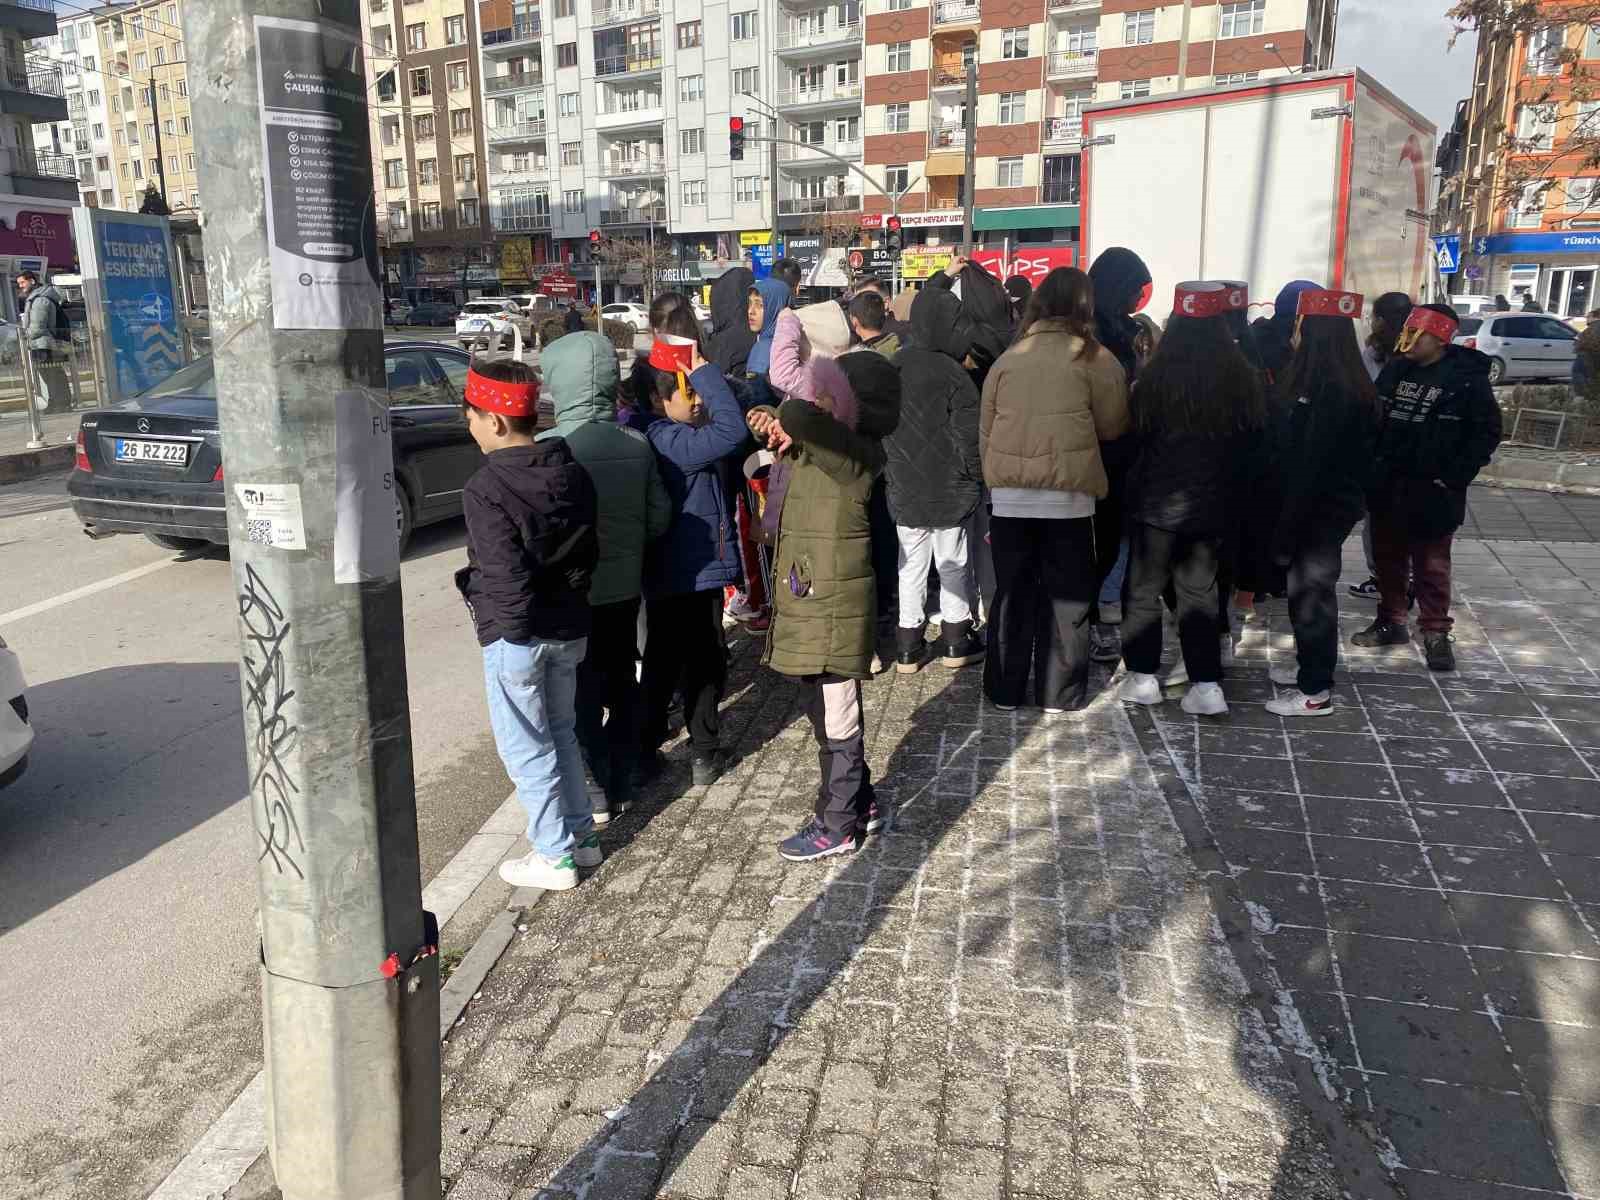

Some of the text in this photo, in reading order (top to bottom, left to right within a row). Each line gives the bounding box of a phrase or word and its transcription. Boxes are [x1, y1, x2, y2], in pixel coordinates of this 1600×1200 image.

[284, 82, 325, 95] ÇALIŞMA
[901, 216, 922, 226] KEPÇE
[104, 241, 162, 260] TERTEMİZ
[372, 416, 390, 436] FU
[124, 442, 185, 460] 26 RZ 222
